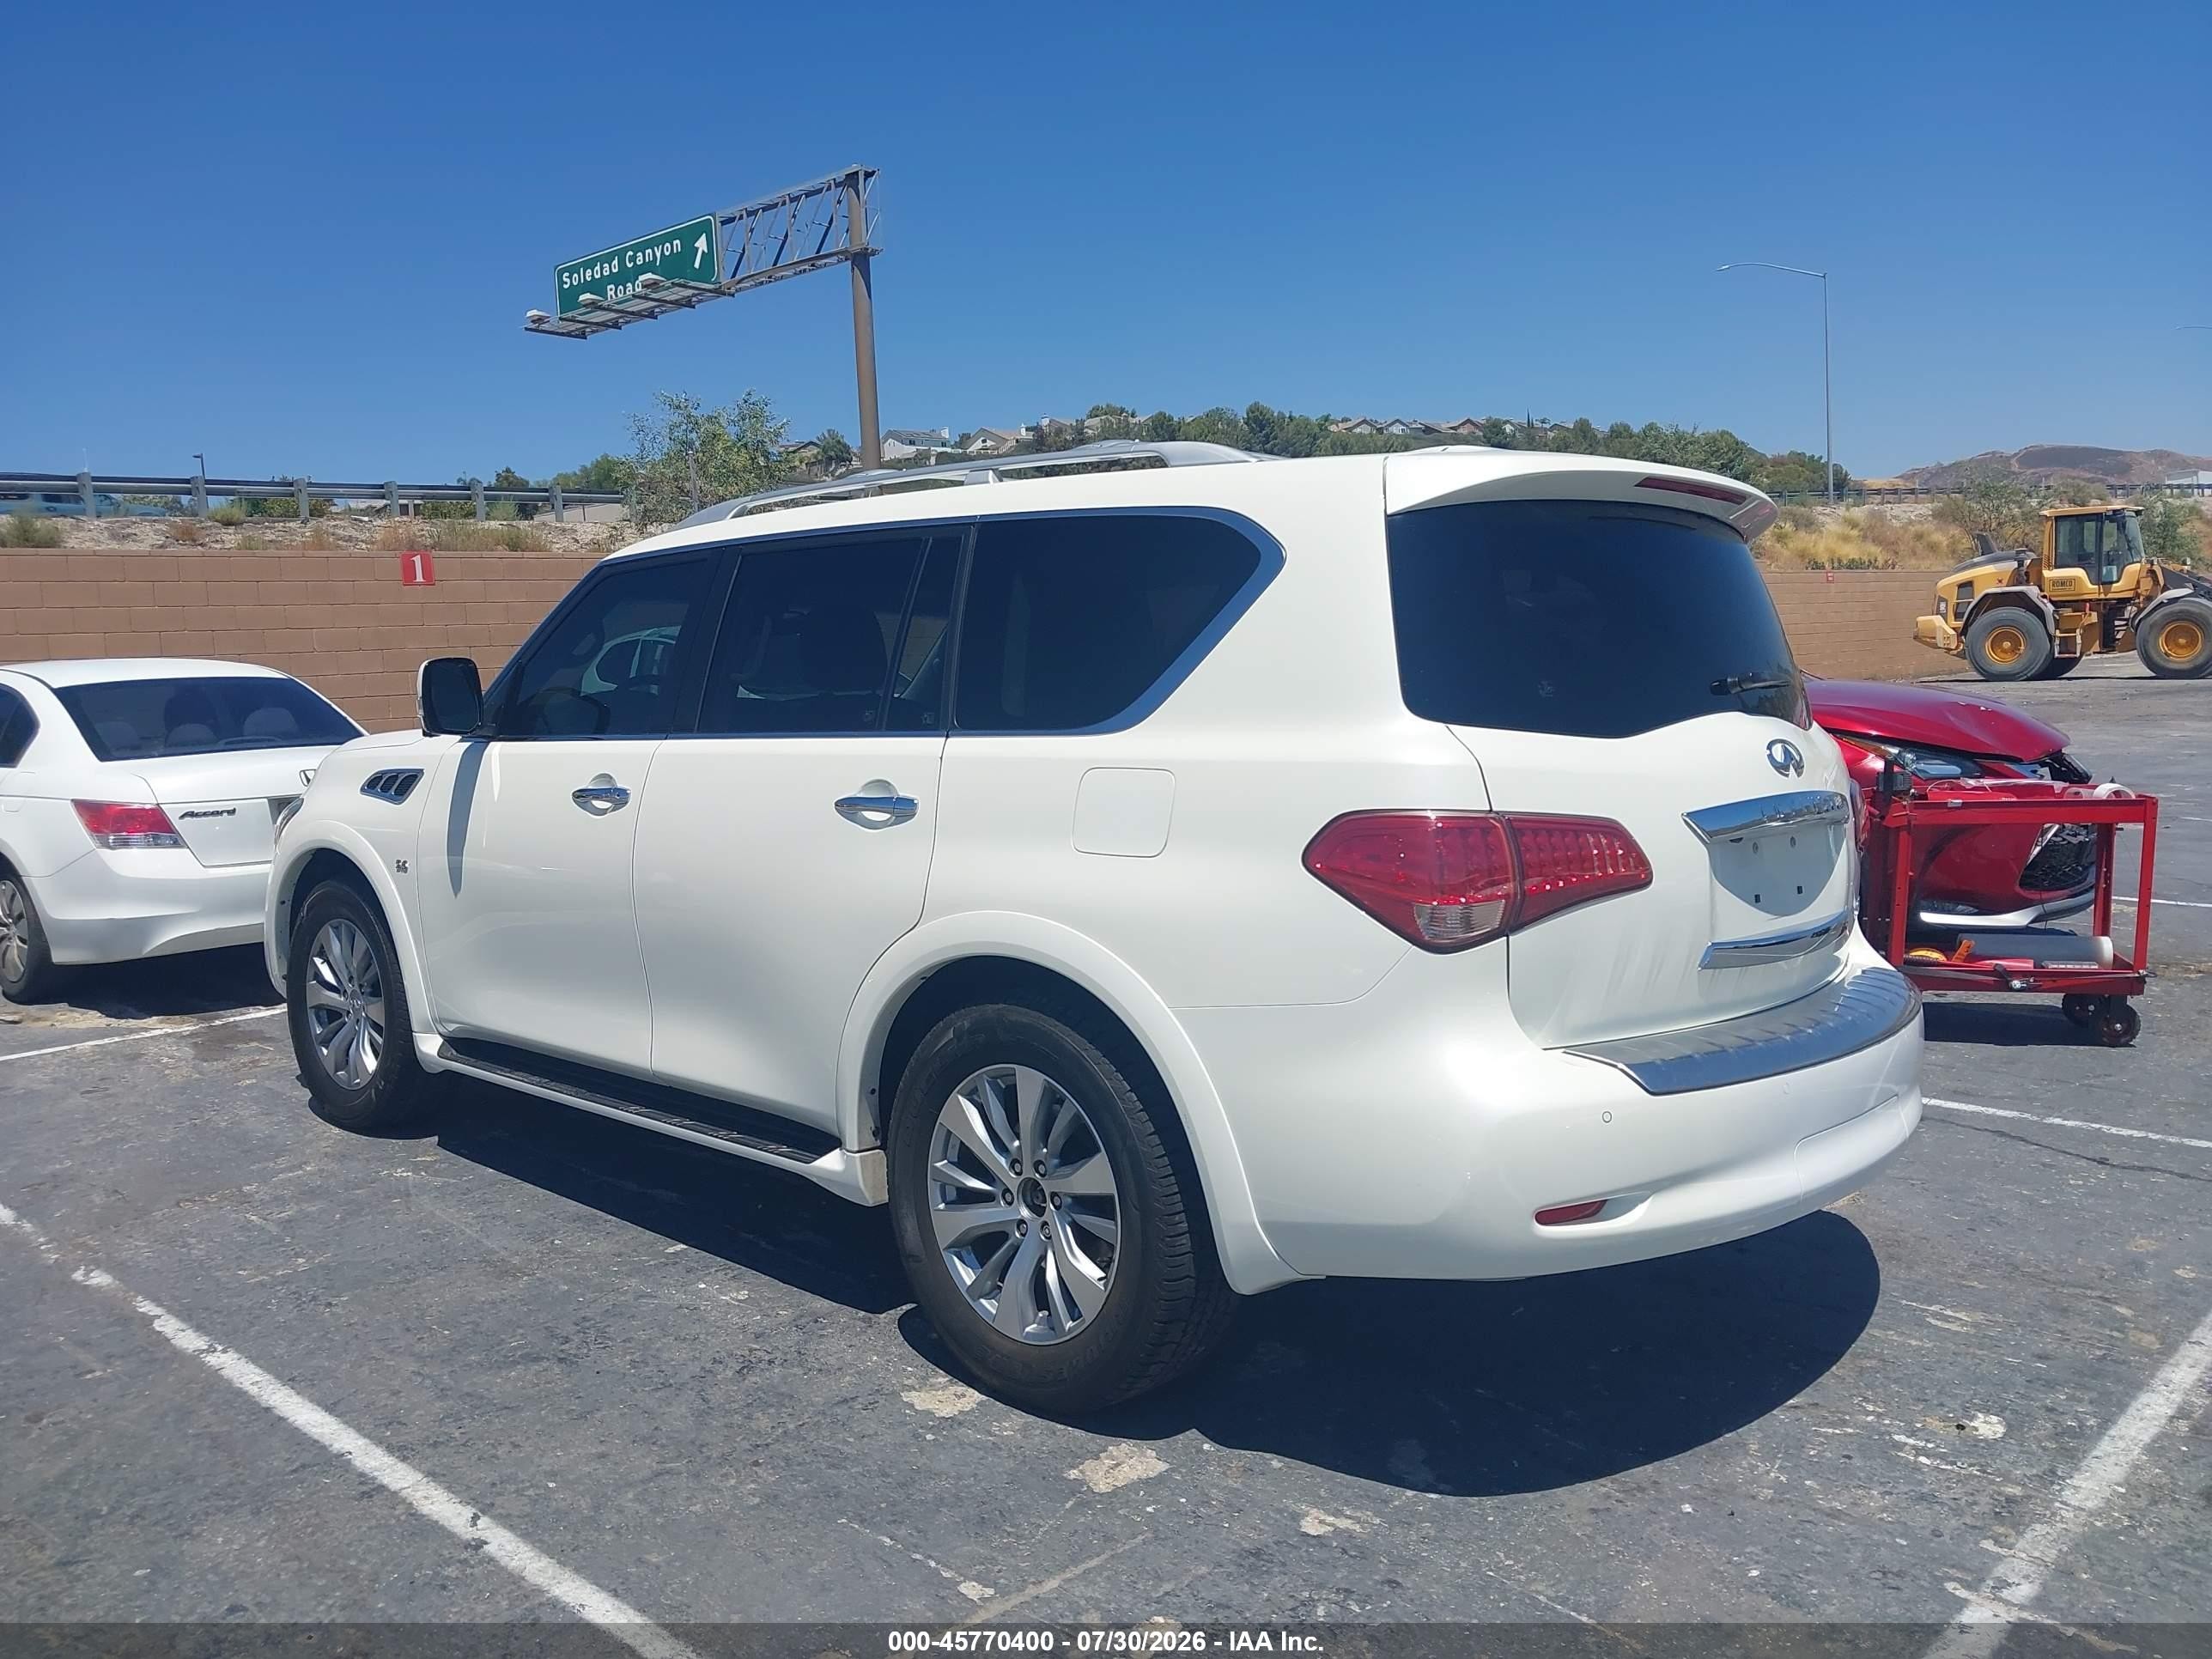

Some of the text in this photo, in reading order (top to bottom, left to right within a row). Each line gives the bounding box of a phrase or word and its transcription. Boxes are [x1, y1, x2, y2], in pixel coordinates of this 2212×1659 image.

[562, 239, 681, 289] Soledad Canyon
[410, 554, 426, 581] 1
[179, 807, 236, 820] Accord
